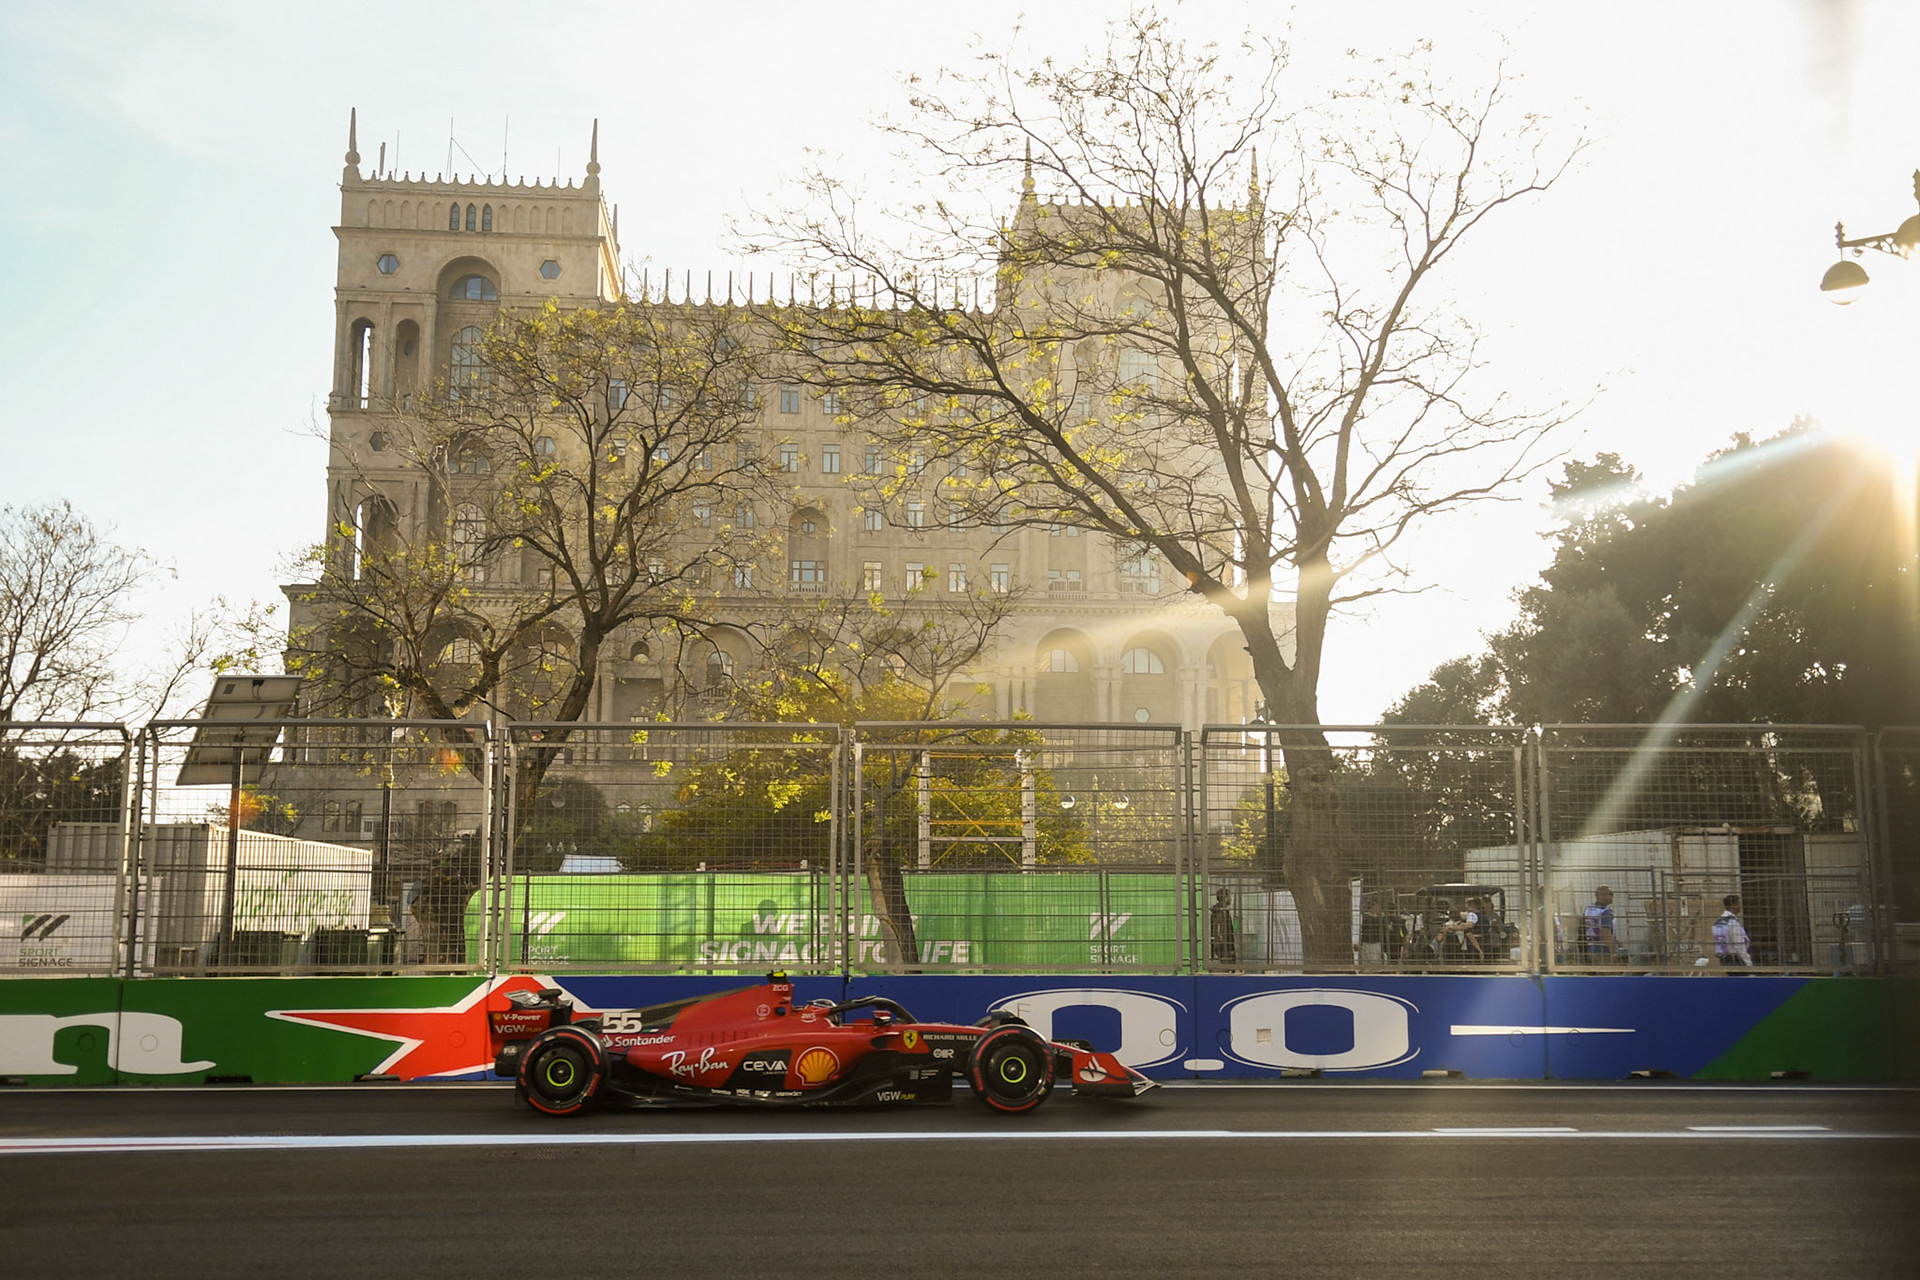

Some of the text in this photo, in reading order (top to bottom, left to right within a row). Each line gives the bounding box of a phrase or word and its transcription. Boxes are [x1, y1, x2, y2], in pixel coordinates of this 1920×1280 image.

[753, 914, 918, 936] WE BRI
[20, 948, 59, 957] SPORT
[521, 946, 557, 955] PORT
[920, 941, 972, 963] IFE
[19, 958, 73, 967] SIGNAGE
[521, 956, 571, 965] IGNAGE
[503, 1013, 541, 1021] V-Power
[602, 1012, 642, 1034] 55
[495, 1025, 526, 1034] VGW
[615, 1035, 676, 1047] Santander
[743, 1060, 788, 1071] CEVA
[877, 1091, 901, 1102] VGW
